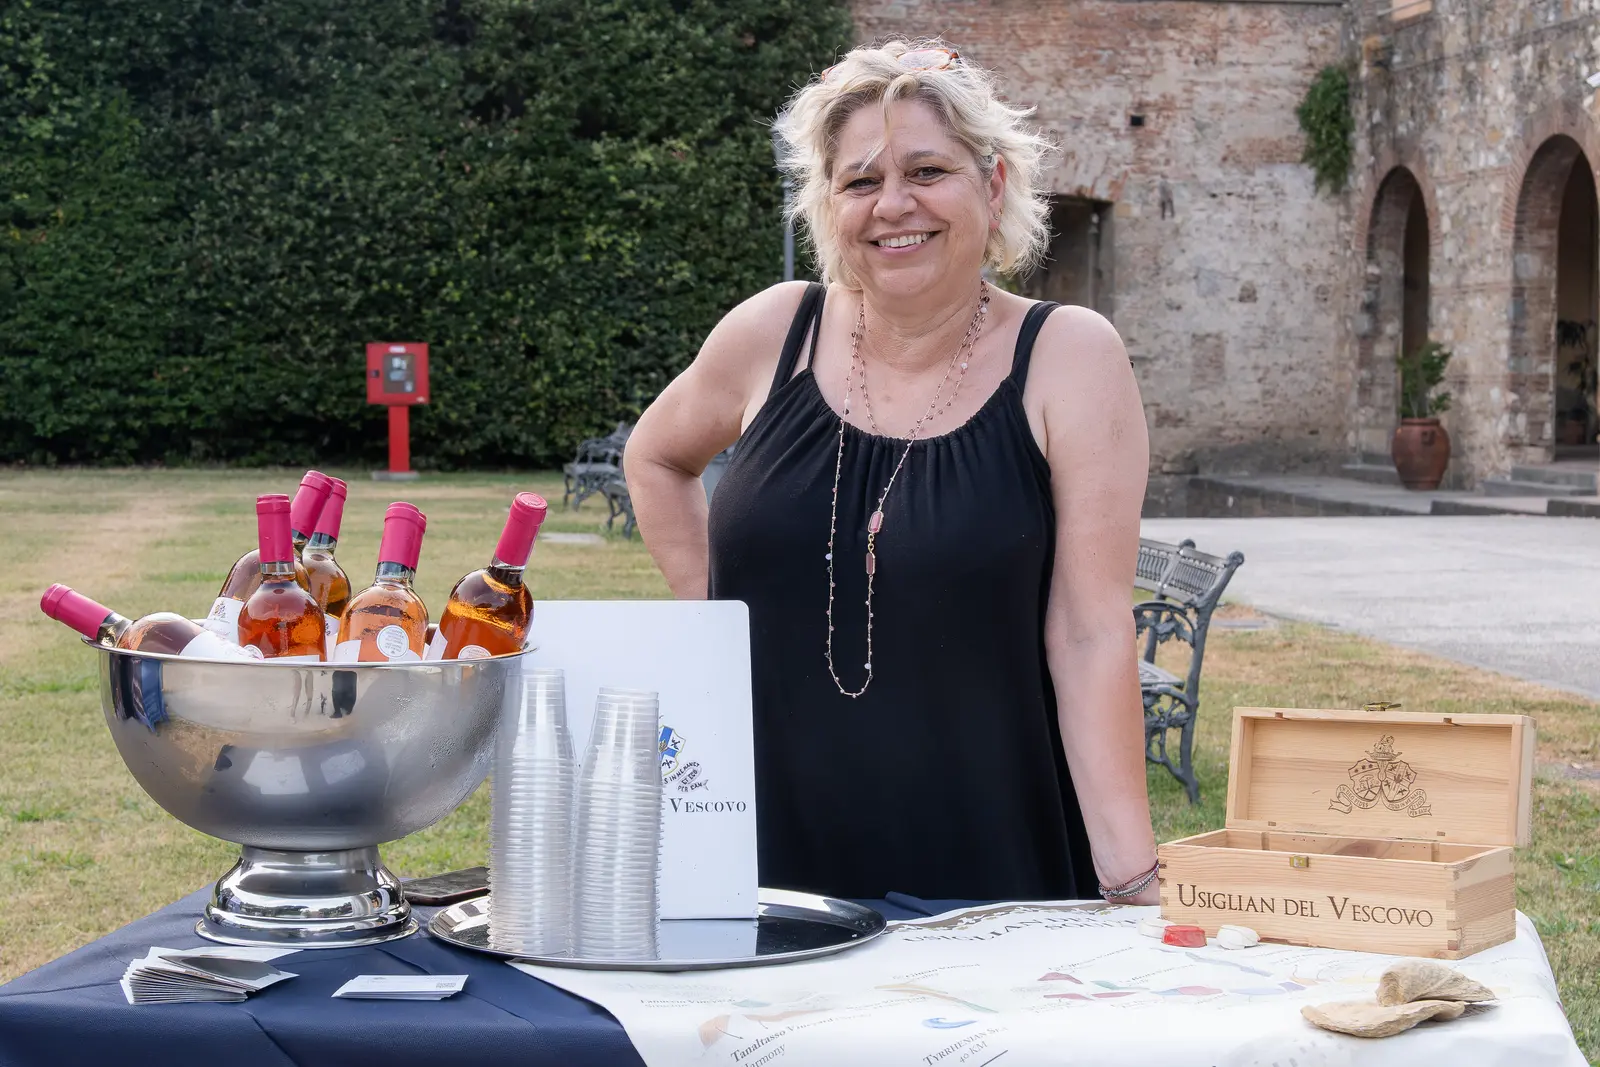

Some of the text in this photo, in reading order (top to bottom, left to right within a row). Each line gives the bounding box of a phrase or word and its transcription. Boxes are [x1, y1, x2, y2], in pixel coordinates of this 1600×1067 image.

[668, 797, 747, 813] VESCOVO
[1176, 883, 1434, 928] USIGLIAN DEL VESCOVO
[730, 1030, 786, 1063] Tanaltasso
[922, 1032, 988, 1067] TYRRHENIAN
[969, 1041, 988, 1055] KM
